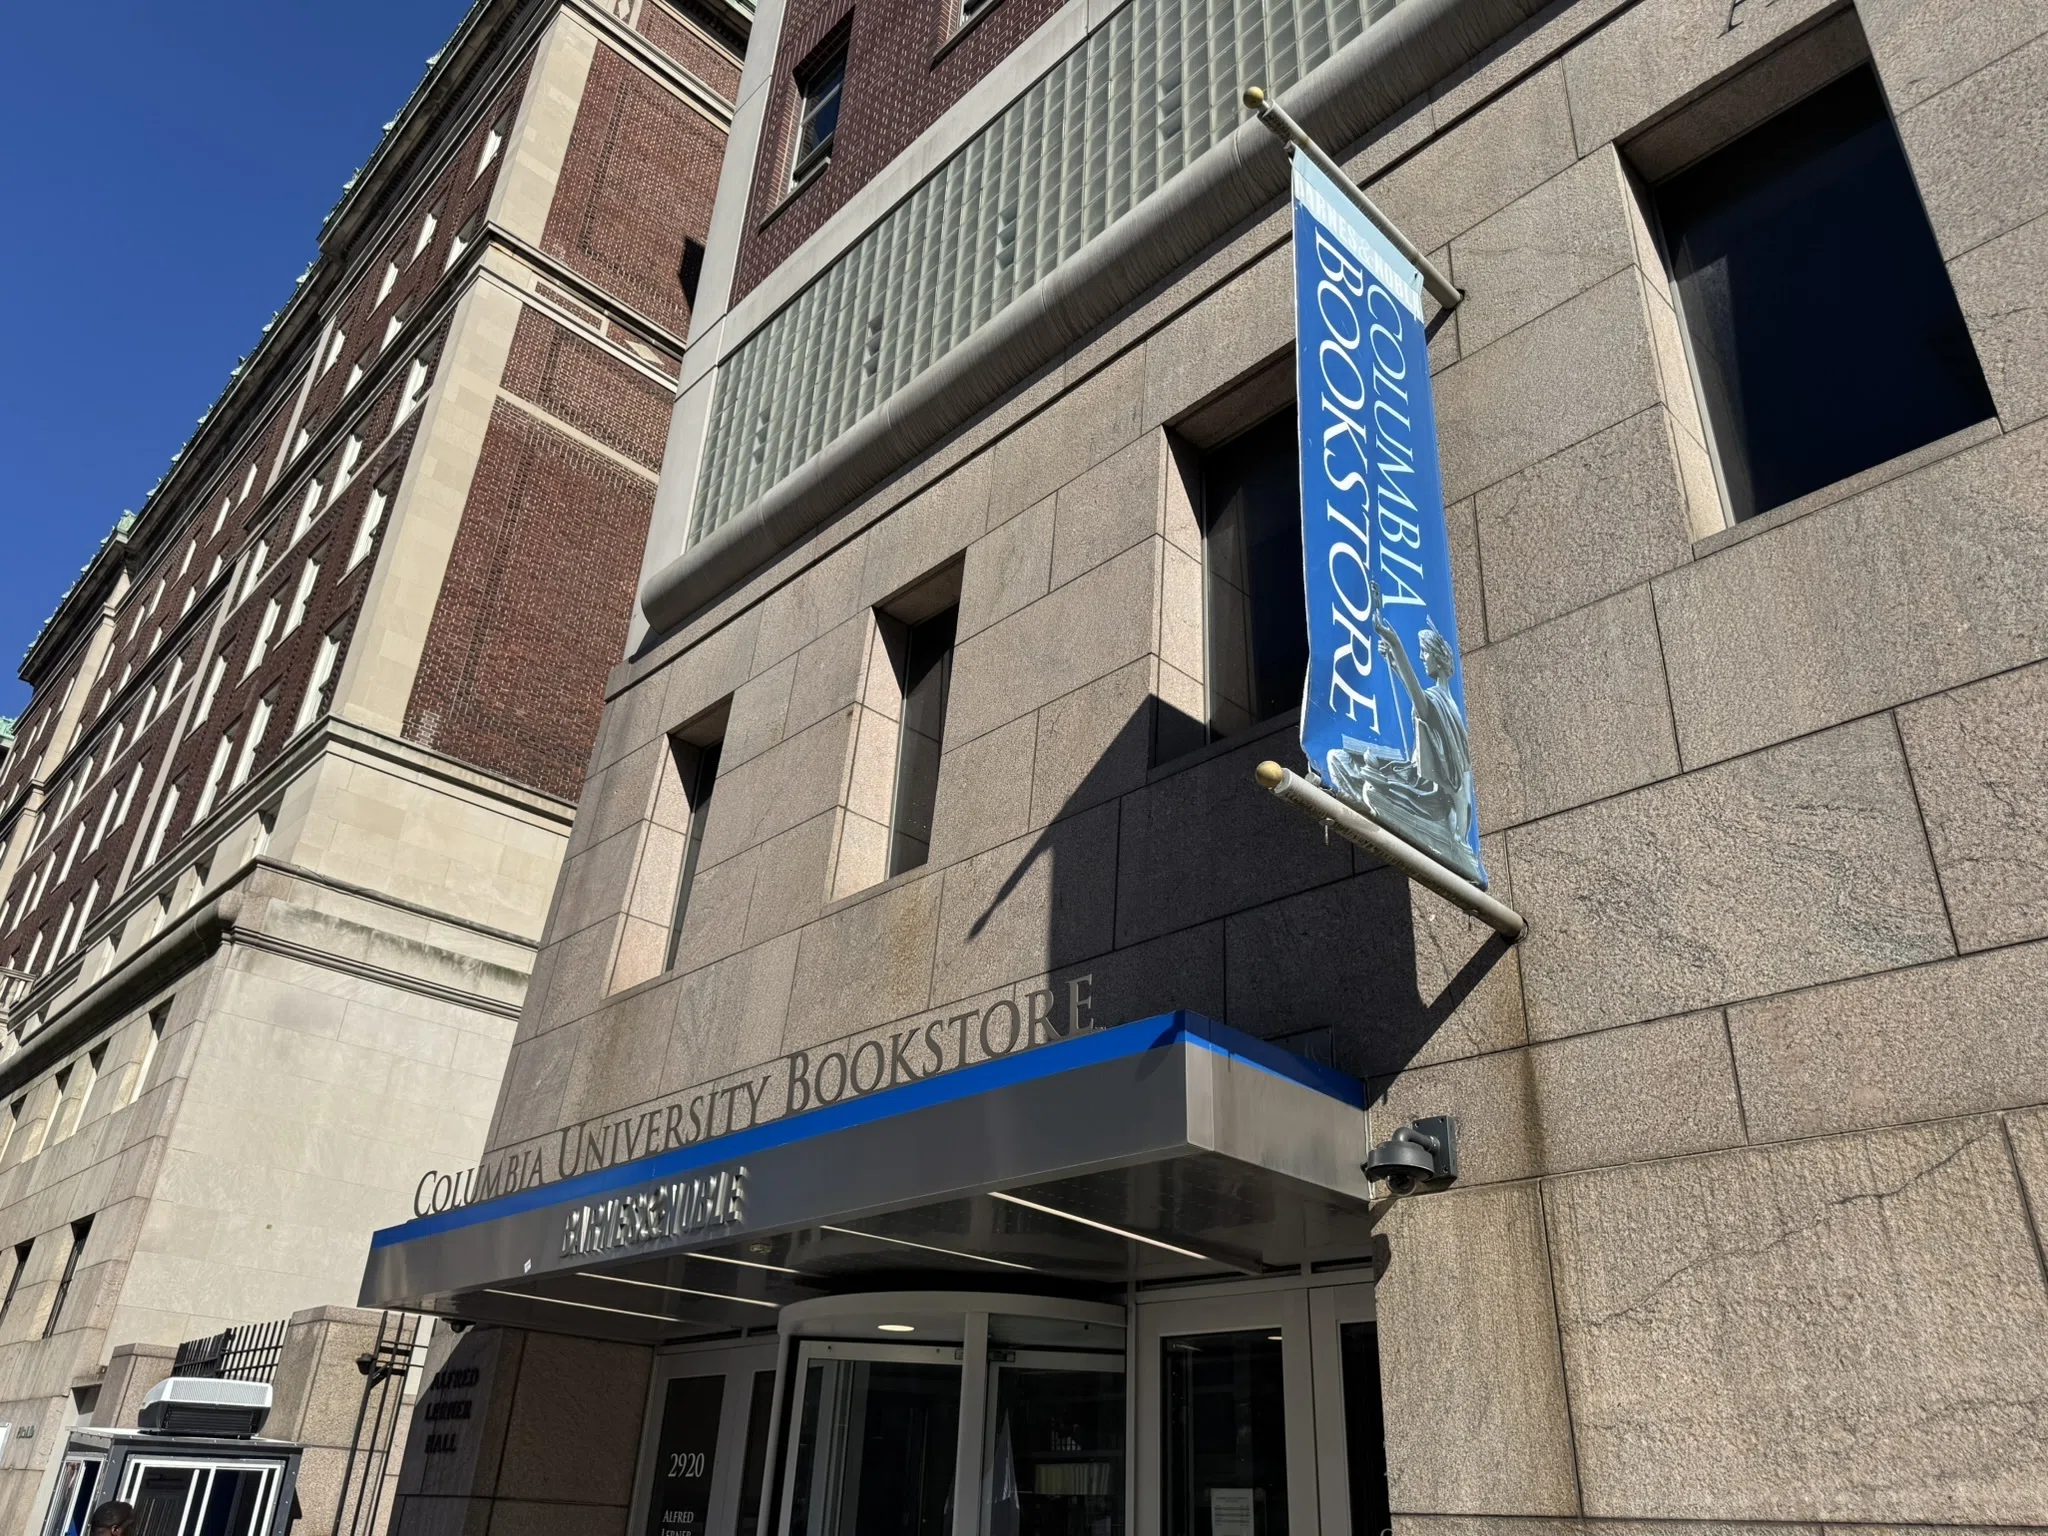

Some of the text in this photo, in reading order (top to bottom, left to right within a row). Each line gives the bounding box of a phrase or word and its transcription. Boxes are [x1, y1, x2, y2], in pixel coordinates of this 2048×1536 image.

[1315, 227, 1381, 735] BOOKSTORE
[1367, 284, 1427, 608] COLUMBIA
[414, 974, 1094, 1219] COLUMBIA UNIVERSITY BOOKSTORE
[424, 1433, 457, 1453] HALL
[668, 1453, 705, 1477] 2920
[662, 1509, 695, 1523] ALFRED
